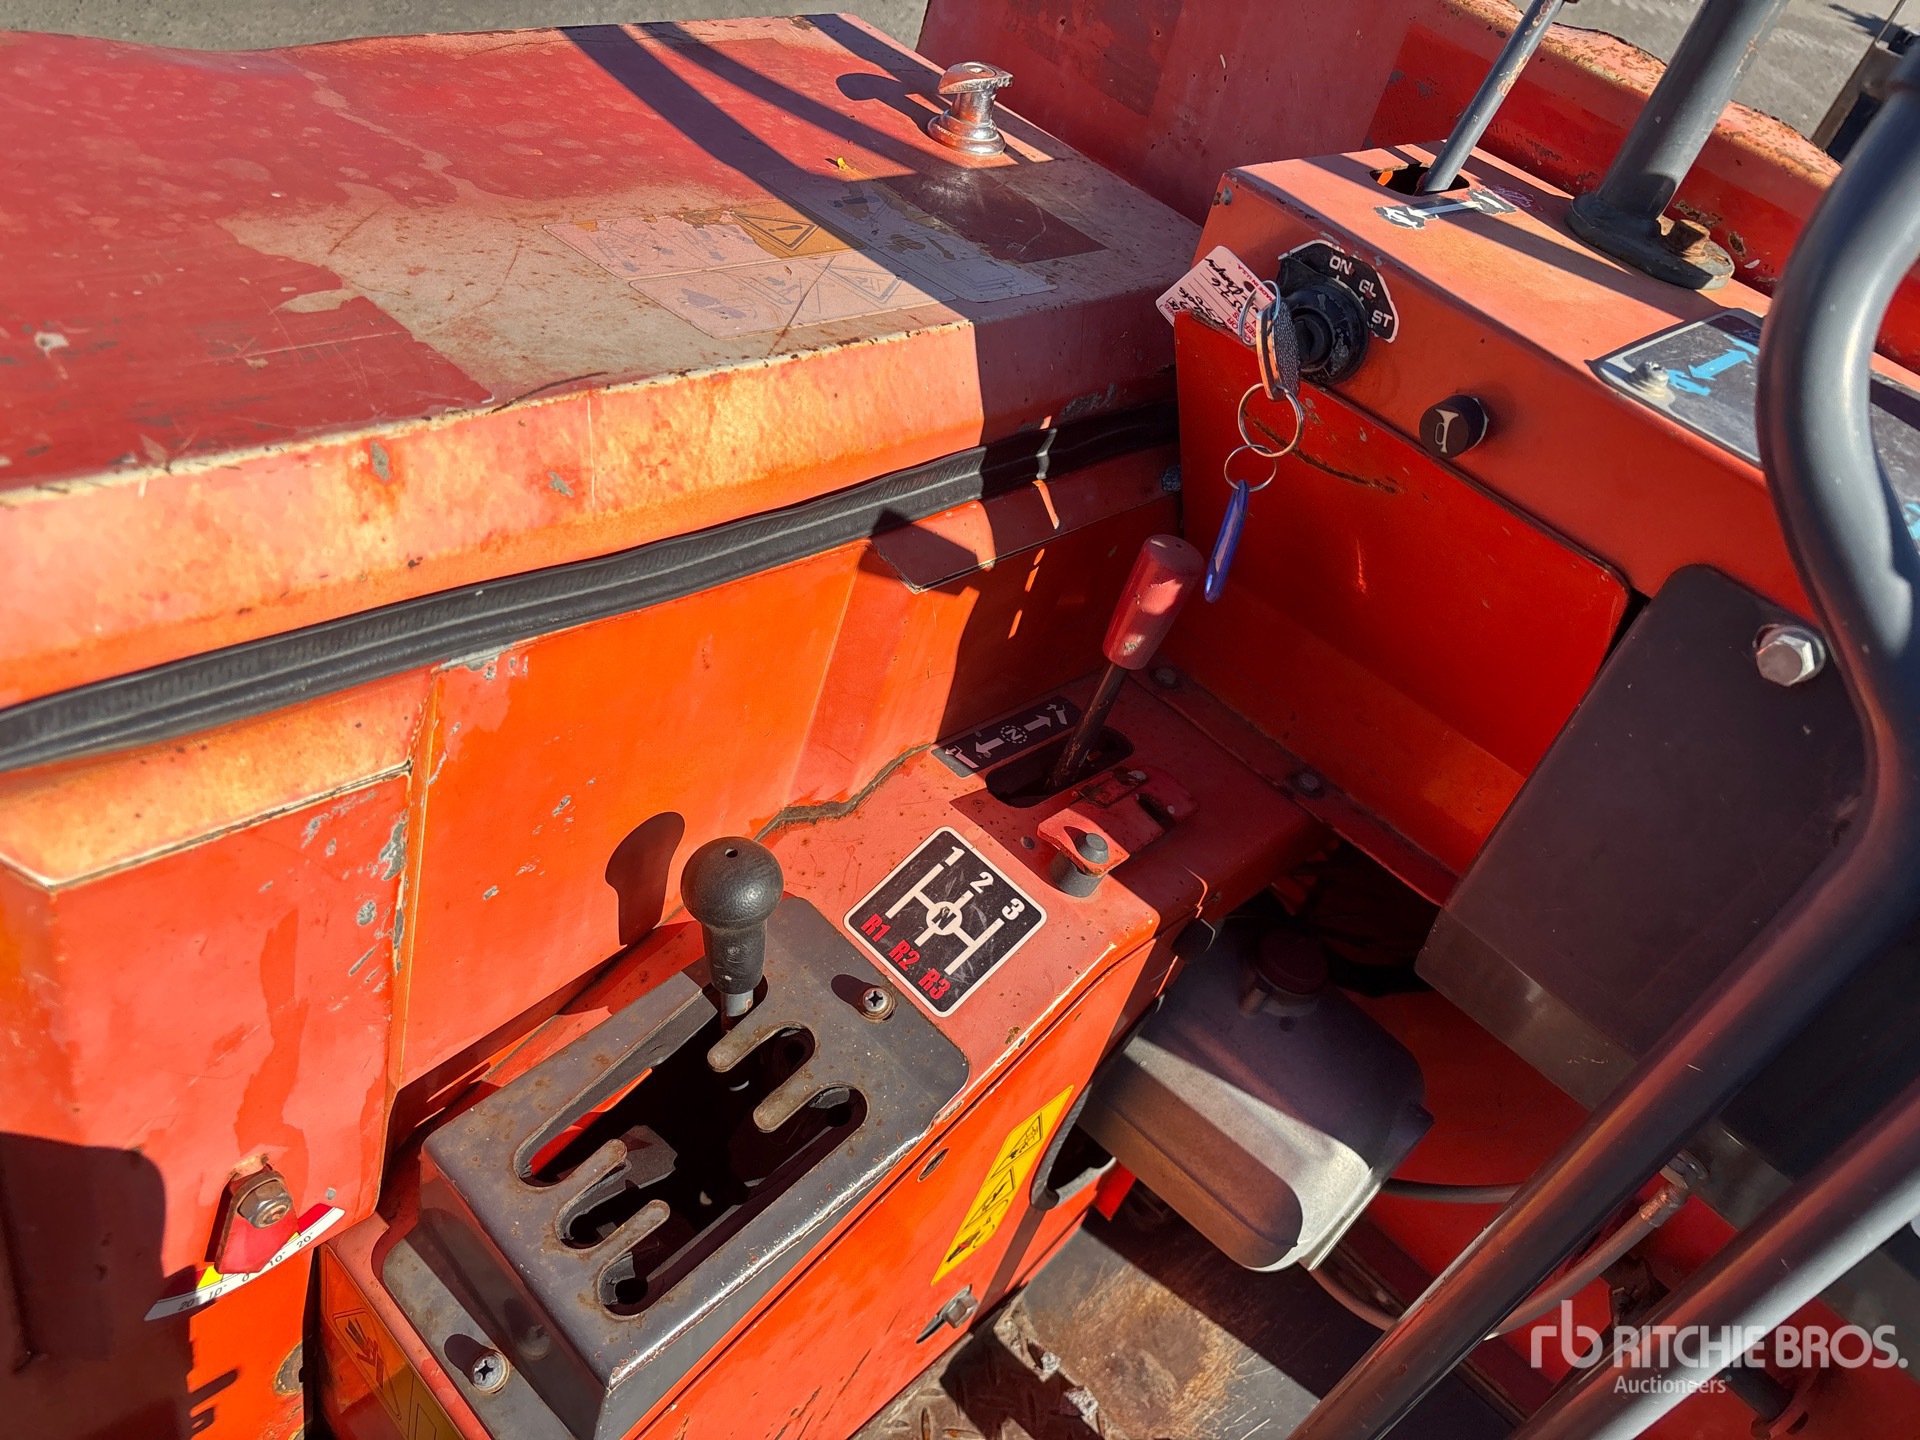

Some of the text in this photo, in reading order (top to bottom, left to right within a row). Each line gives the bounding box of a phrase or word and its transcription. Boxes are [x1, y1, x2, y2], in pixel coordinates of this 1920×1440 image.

[1329, 255, 1353, 276] ON
[1358, 279, 1378, 299] GL
[1371, 310, 1394, 328] ST
[1004, 728, 1023, 742] N
[944, 846, 1026, 921] 1 2 3
[931, 910, 958, 931] N
[860, 913, 951, 1001] R1 R2 R3
